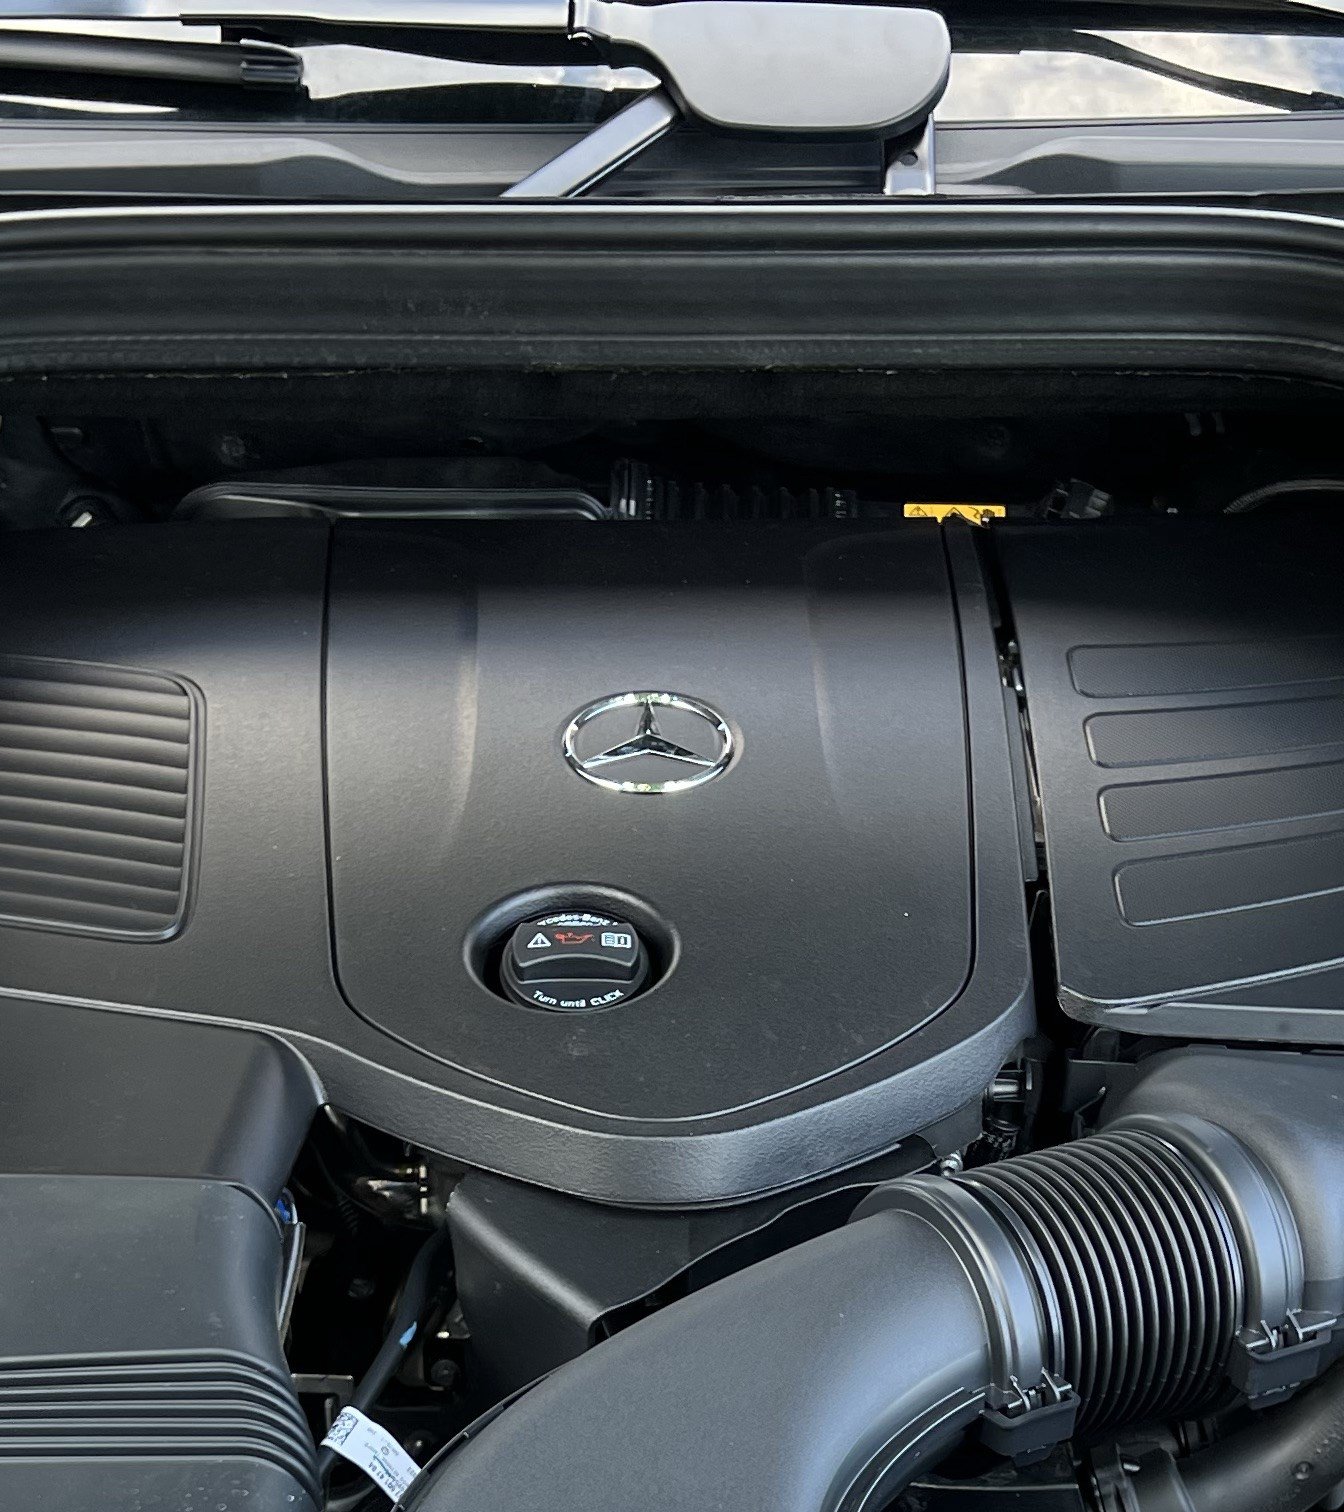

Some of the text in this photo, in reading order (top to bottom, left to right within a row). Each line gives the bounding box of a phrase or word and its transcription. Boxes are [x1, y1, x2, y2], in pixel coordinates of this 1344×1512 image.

[533, 989, 624, 1008] Turn until CLICK
